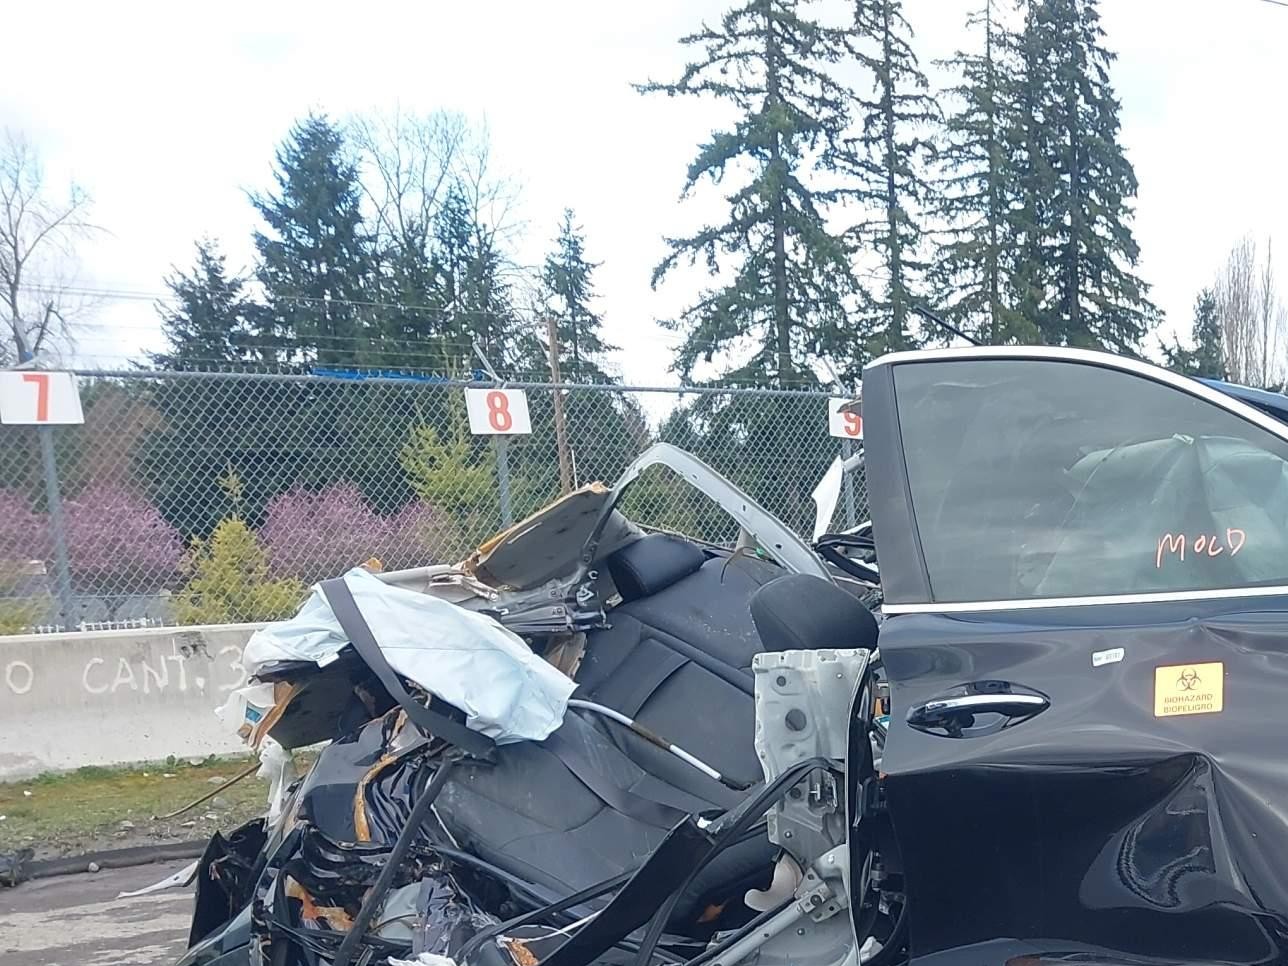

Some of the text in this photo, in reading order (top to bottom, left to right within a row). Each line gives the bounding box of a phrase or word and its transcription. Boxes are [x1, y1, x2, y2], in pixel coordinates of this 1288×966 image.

[23, 374, 48, 421] 7
[487, 391, 512, 431] 8
[844, 411, 861, 436] 9
[1156, 528, 1245, 568] MOLD
[83, 655, 205, 696] CANT.
[1163, 703, 1213, 713] BIOPELIGRO
[1164, 693, 1213, 704] BIOHAZARD
